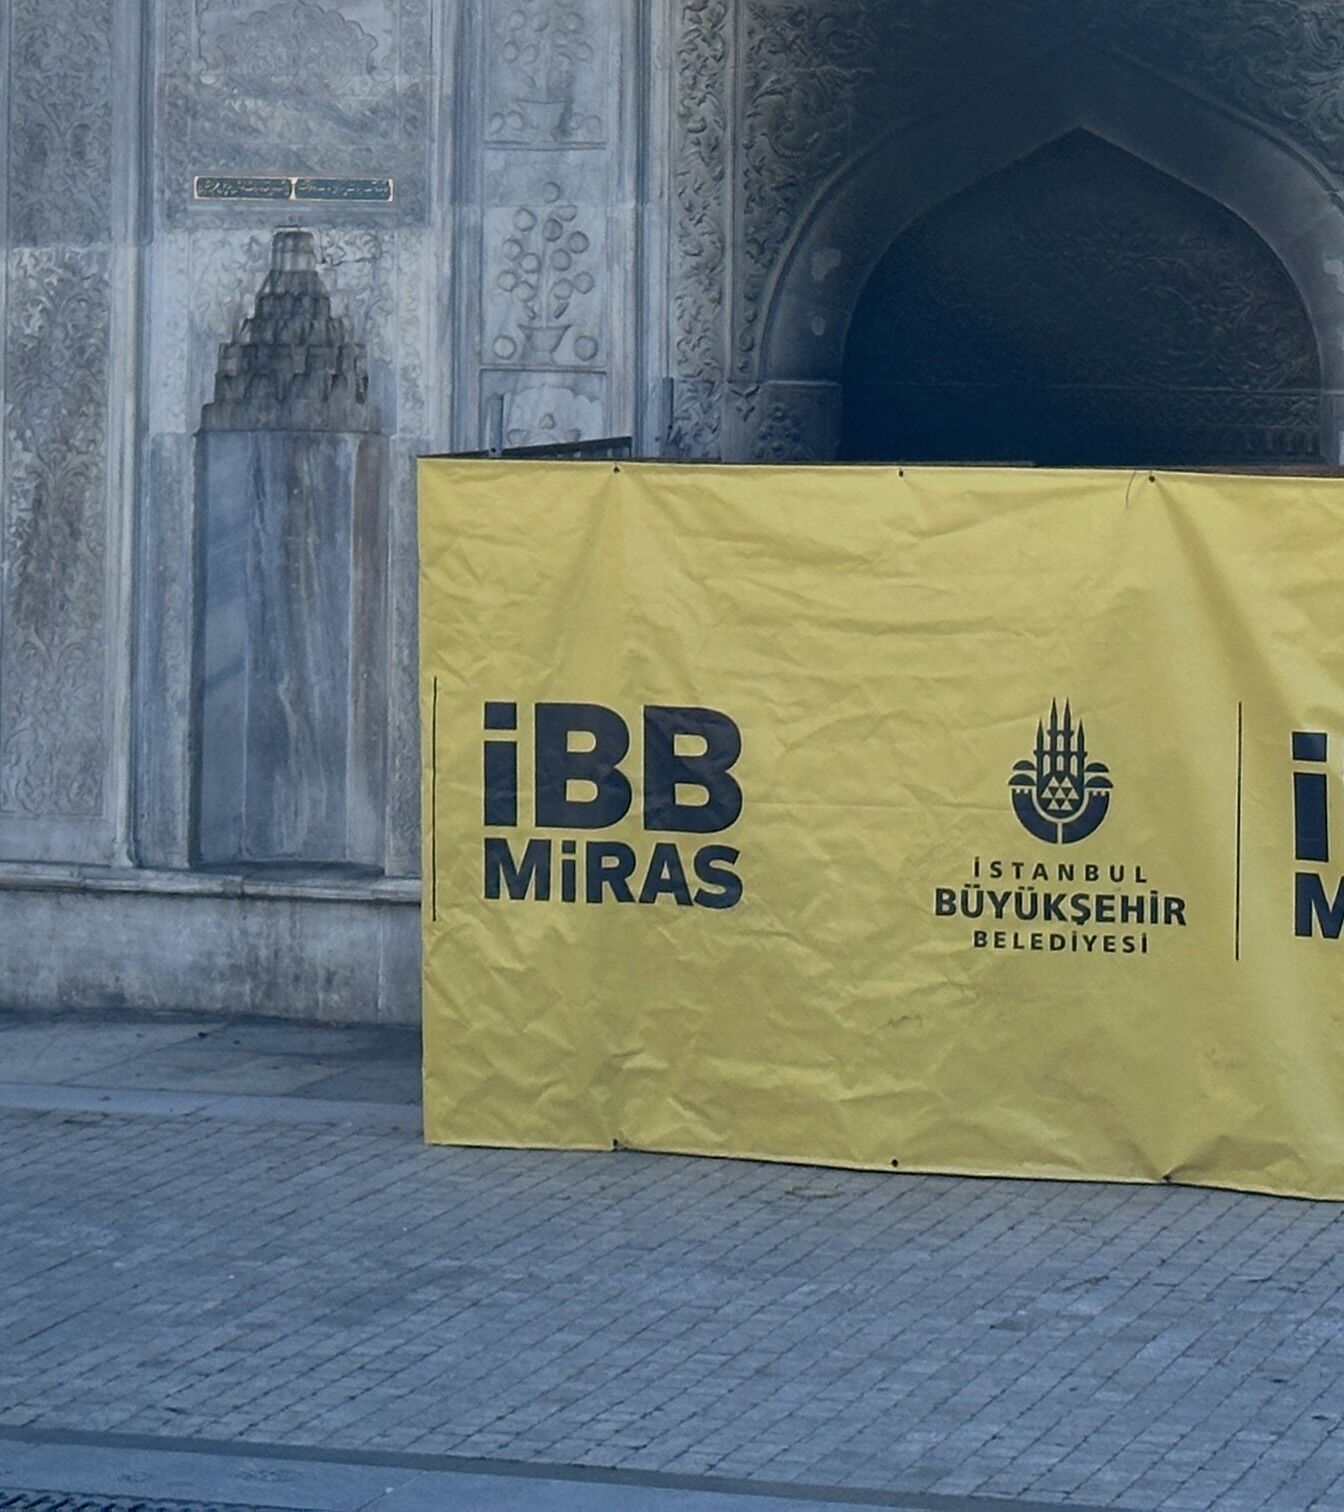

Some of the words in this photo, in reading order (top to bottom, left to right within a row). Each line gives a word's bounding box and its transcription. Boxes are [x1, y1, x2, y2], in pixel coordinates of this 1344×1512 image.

[973, 856, 1148, 884] İSTANBUL
[934, 883, 1187, 926] BÜYÜKŞEHİR
[973, 929, 1148, 954] BELEDİYESİ
